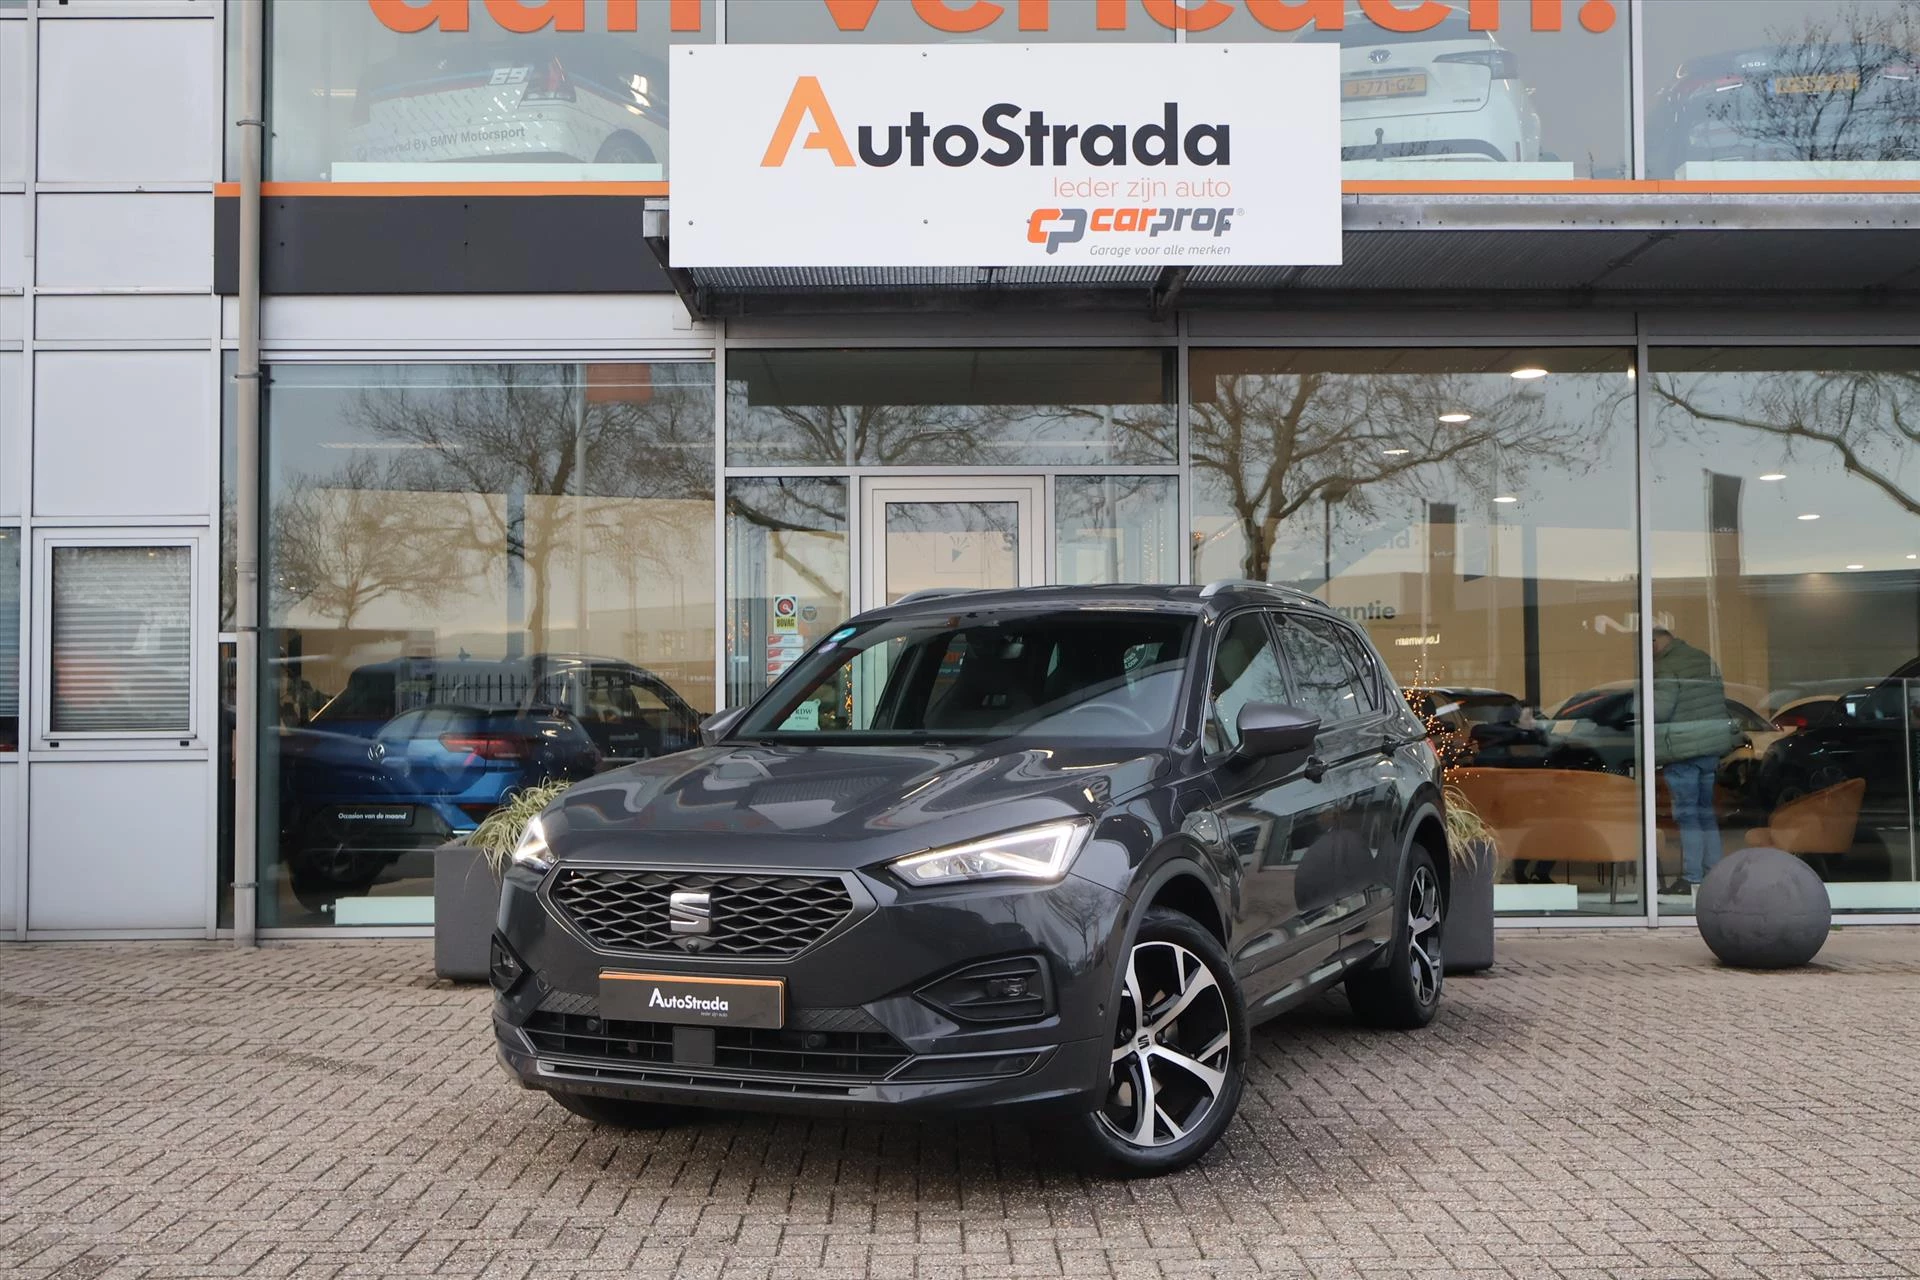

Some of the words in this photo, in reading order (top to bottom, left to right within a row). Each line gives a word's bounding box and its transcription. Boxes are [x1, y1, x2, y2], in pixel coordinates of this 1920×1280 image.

[760, 76, 1230, 167] AutoStrada
[430, 132, 458, 147] BMW
[461, 126, 526, 143] Motorsport
[1053, 177, 1119, 197] Ieder
[1127, 178, 1167, 202] zijn
[1175, 180, 1231, 198] auto
[1090, 208, 1234, 237] carprof
[1090, 245, 1130, 258] Garage
[1134, 246, 1161, 255] voor
[1164, 244, 1185, 255] alle
[1188, 244, 1231, 255] merken
[376, 811, 384, 820] de
[649, 987, 729, 1011] AutoStrada
